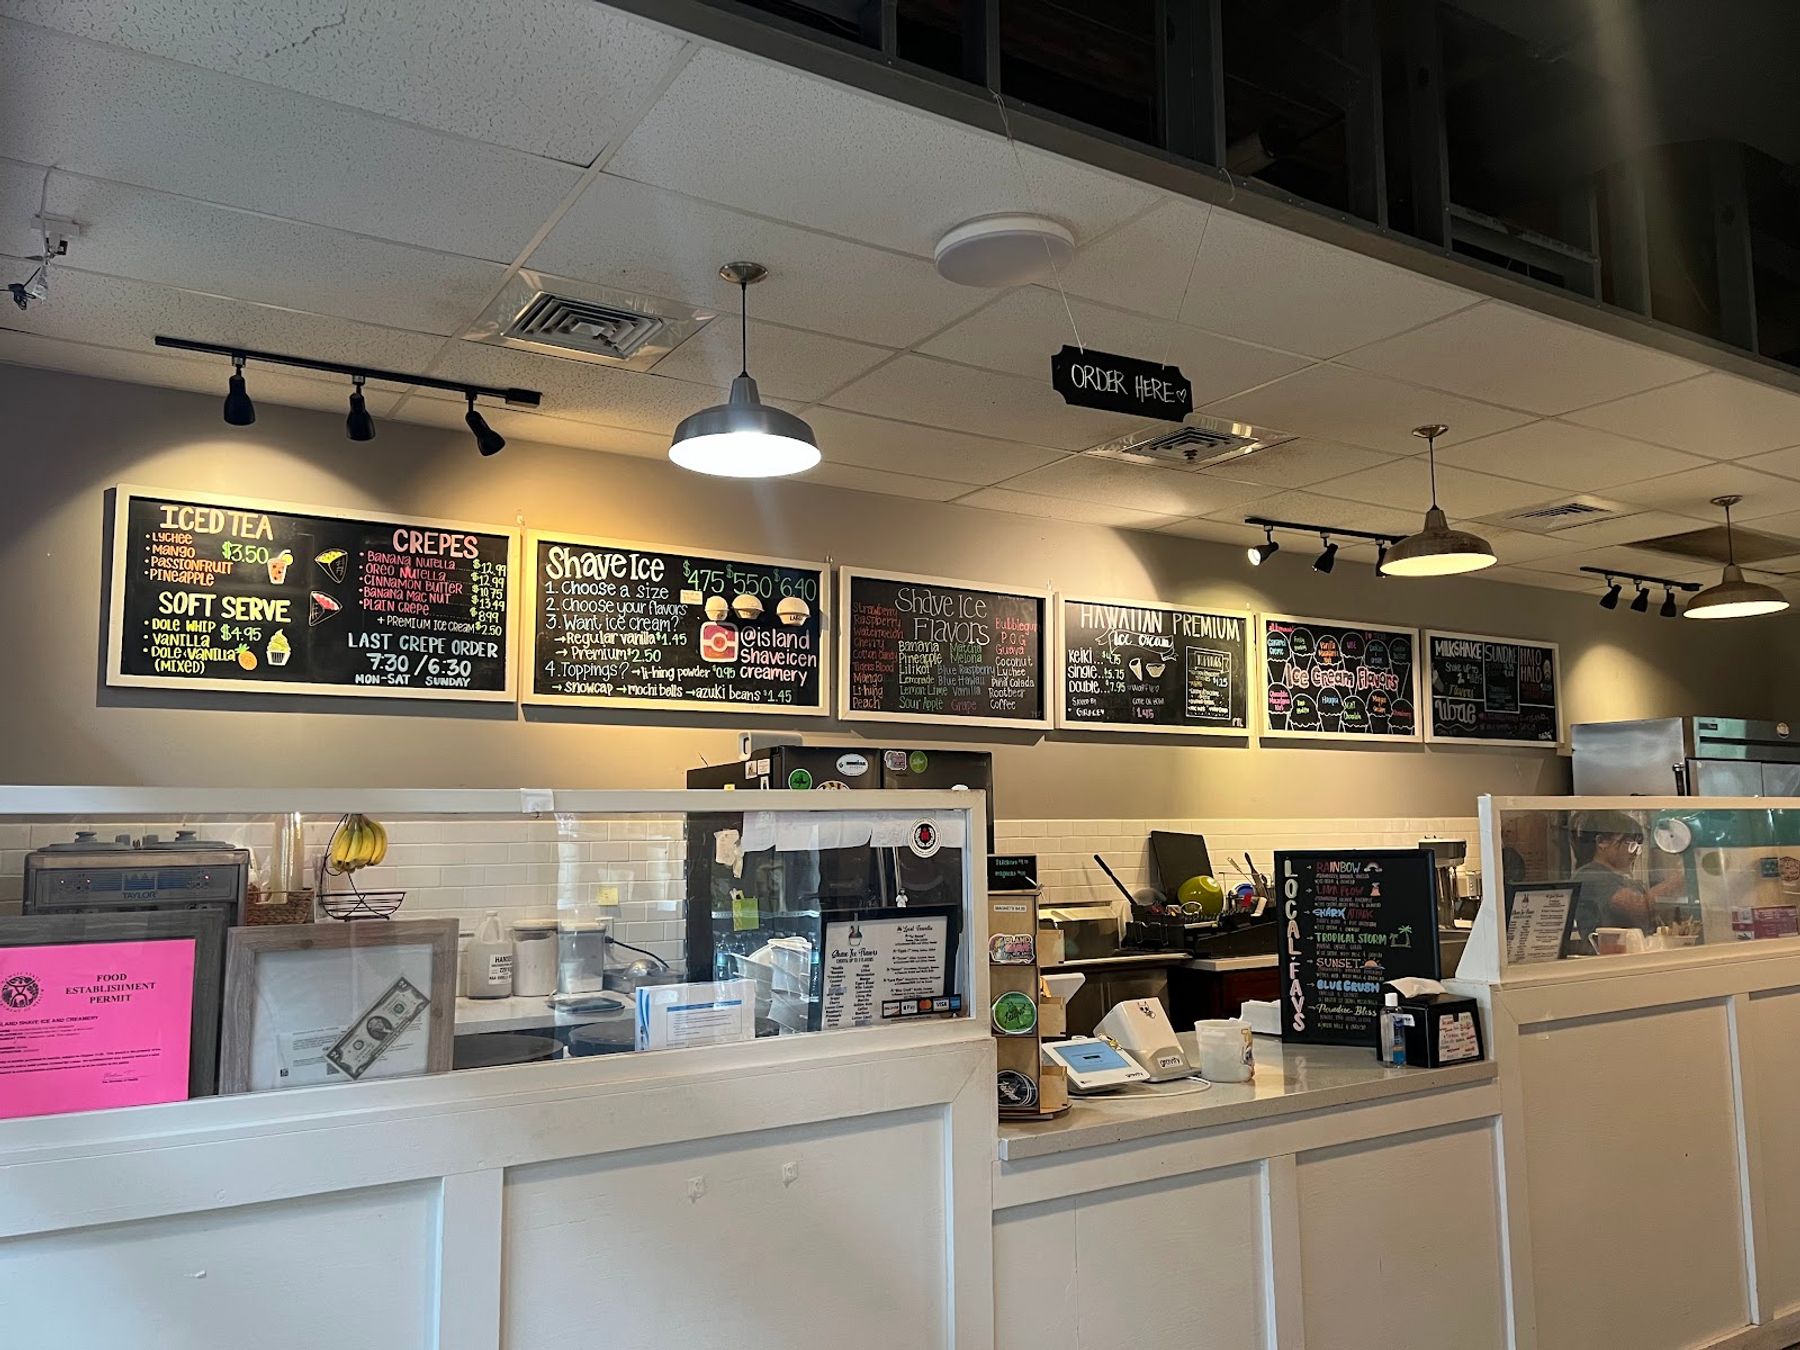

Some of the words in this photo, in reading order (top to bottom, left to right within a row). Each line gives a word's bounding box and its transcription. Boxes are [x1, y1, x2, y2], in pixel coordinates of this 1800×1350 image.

[1071, 364, 1128, 395] ORDER
[1135, 375, 1175, 403] HERE
[160, 505, 224, 534] ICED
[228, 511, 273, 540] TEA
[222, 541, 268, 564] $3.50
[393, 529, 479, 559] CREPES
[545, 546, 627, 580] Shave
[630, 554, 664, 582] Ice
[545, 581, 559, 594] 1.
[562, 581, 616, 596] Choose
[620, 585, 630, 597] a
[636, 582, 669, 599] size
[159, 591, 217, 617] SOFT
[221, 597, 291, 623] SERVE
[364, 599, 395, 612] PLAIN
[546, 598, 560, 611] 2.
[562, 598, 614, 612] Choose
[617, 602, 646, 617] your
[649, 601, 688, 616] flavors
[895, 588, 953, 617] Shave
[959, 595, 987, 618] Ice
[152, 618, 180, 630] DOLE
[186, 620, 216, 632] WHIP
[546, 614, 561, 629] 3.
[606, 615, 626, 630] ice
[629, 616, 679, 632] cream?
[914, 618, 990, 645] Flavors
[1081, 603, 1162, 633] HAWAIIAN
[1173, 613, 1240, 642] PREMIUM
[349, 633, 392, 650] LAST
[400, 635, 447, 654] CREPE
[452, 640, 498, 658] ORDER
[566, 632, 617, 648] Regular
[621, 632, 656, 644] vanilla
[656, 632, 687, 645] $1.45
[741, 626, 809, 649] @island
[571, 645, 627, 661] Premium
[627, 647, 661, 662] $2.50
[899, 641, 939, 653] Banana
[1435, 640, 1482, 659] MILKSHAKE
[367, 653, 409, 672] 7:30
[428, 658, 471, 677] 6:30
[899, 651, 942, 665] Pineapple
[995, 656, 1033, 666] Coconut
[355, 673, 410, 684] MON-SAT
[425, 676, 471, 687] SUNDAY
[561, 661, 629, 681] Toppings?
[678, 666, 710, 681] powder
[740, 666, 807, 687] creamery
[1285, 663, 1309, 689] Ice
[1311, 666, 1354, 687] Cream
[1356, 666, 1398, 691] Flavors
[564, 681, 613, 695] snowcap
[628, 683, 657, 696] mochi
[659, 683, 682, 697] balls
[696, 684, 725, 699] azuki
[729, 685, 760, 701] beans
[763, 689, 792, 702] $1.45
[853, 697, 880, 709] Peach
[1316, 862, 1361, 874] RAINBOW
[122, 891, 157, 899] TAYLOR
[1312, 907, 1346, 920] SHARK
[1315, 933, 1356, 944] TROPICAL
[1359, 933, 1387, 945] STORM
[1316, 958, 1361, 969] SUNSET
[97, 973, 127, 982] FOOD
[1317, 980, 1342, 991] BLUE
[1343, 981, 1380, 993] CRUSH
[66, 982, 155, 994] ESTABLISHMENT
[90, 995, 132, 1004] PERMIT
